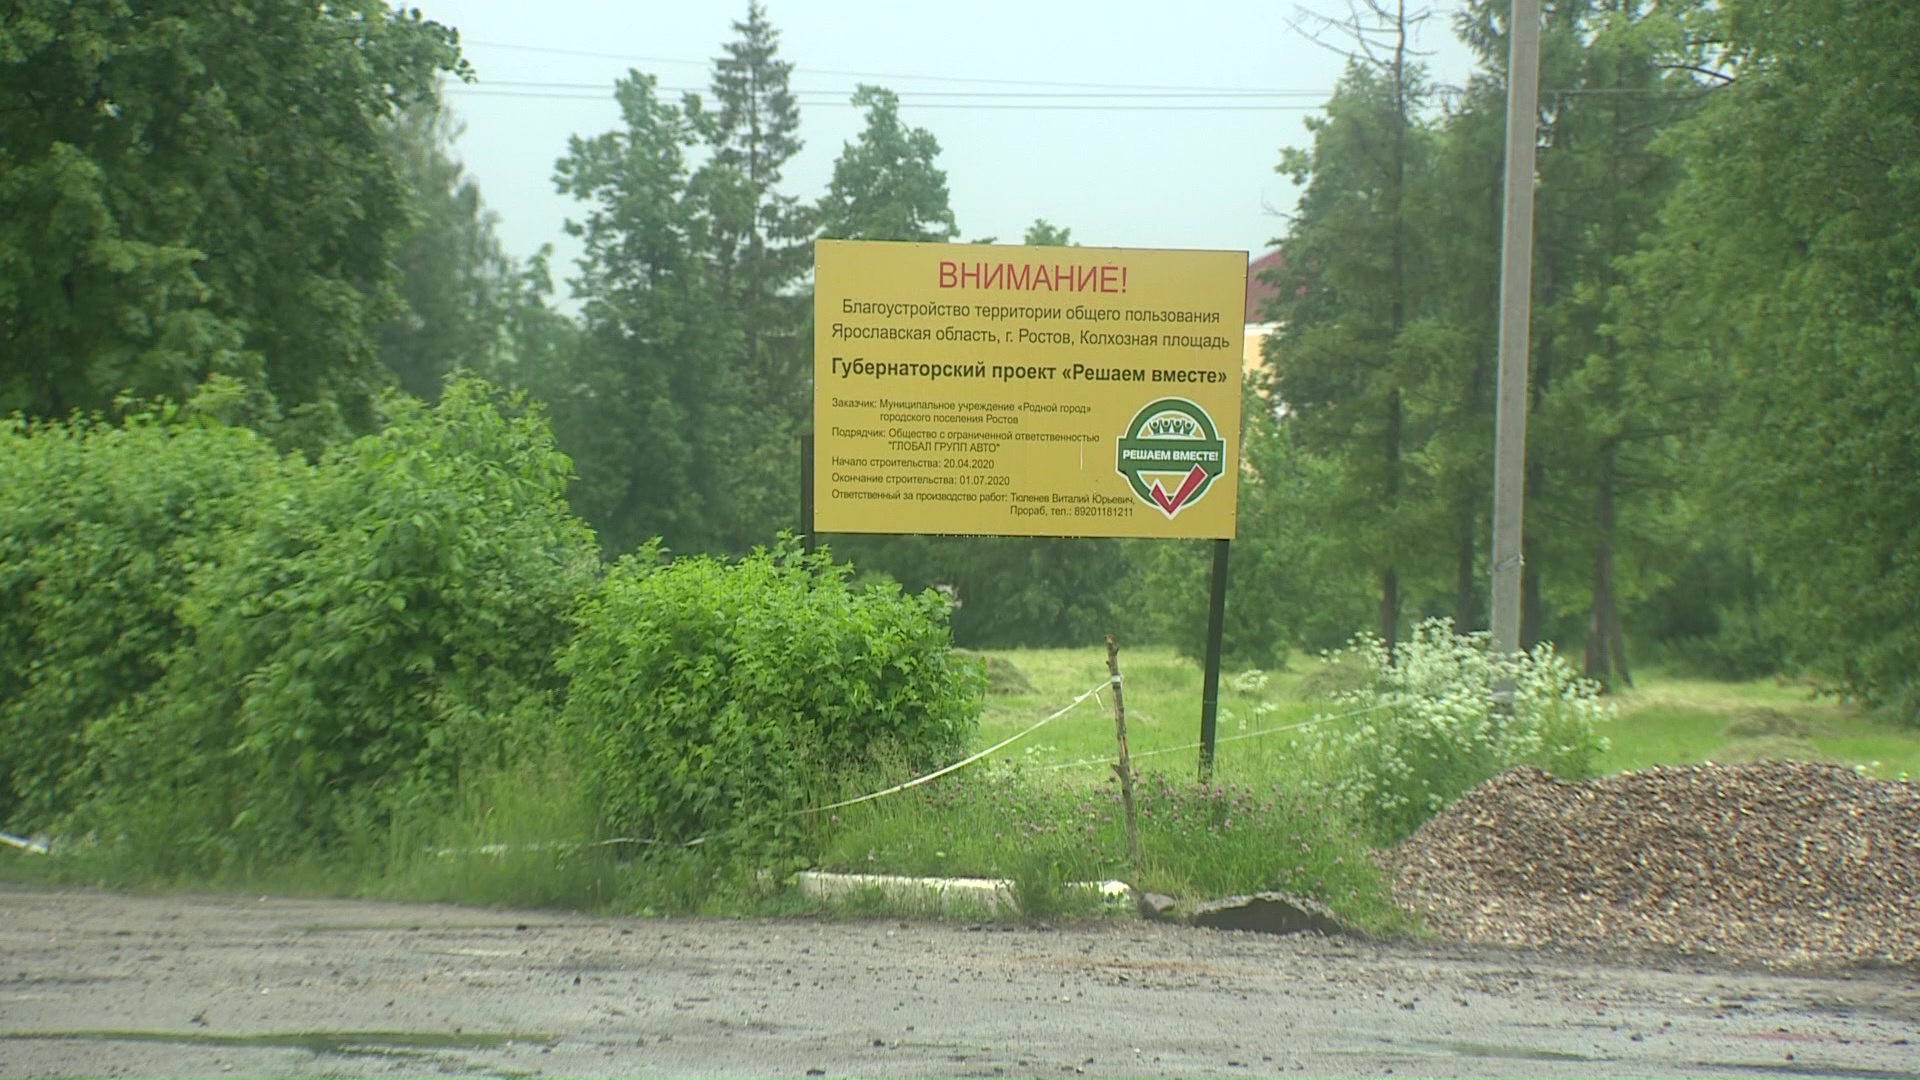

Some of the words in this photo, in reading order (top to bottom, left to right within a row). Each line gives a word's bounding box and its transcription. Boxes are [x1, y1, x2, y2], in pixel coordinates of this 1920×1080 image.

[939, 261, 1127, 293] ВНИМАНИЕ!
[842, 299, 970, 319] Благоустройство
[975, 304, 1061, 322] территории
[1066, 305, 1121, 322] общего
[1125, 309, 1220, 324] пользования
[831, 323, 931, 341] Ярославская
[935, 326, 1001, 344] область,
[1005, 333, 1014, 343] г.
[1019, 328, 1075, 346] Ростов,
[1080, 330, 1158, 347] Колхозная
[1162, 335, 1230, 350] площадь
[831, 357, 986, 380] Губернаторский
[992, 365, 1056, 382] проект
[1062, 363, 1145, 383] «Решаем
[1152, 368, 1227, 384] вместе»
[880, 398, 956, 411] Муниципальное
[958, 402, 1015, 413] учреждение
[880, 413, 931, 423] городского
[933, 415, 984, 424] поселения
[986, 414, 1019, 424] Ростов
[888, 427, 937, 439] Общество
[947, 431, 1013, 441] ограниченной
[1015, 432, 1100, 442] ответственностью
[934, 442, 967, 452] ГРУПП
[832, 456, 868, 467] Начало
[870, 459, 942, 469] строительства:
[943, 458, 995, 469] 20.04.2020
[1122, 449, 1171, 461] РЕШАЕМ
[1172, 450, 1219, 461] ВМЕСТЕ!
[832, 472, 883, 483] Окончание
[886, 476, 957, 485] строительства:
[959, 475, 1010, 485] 01.07.2020
[832, 488, 901, 500] Ответственный
[903, 492, 914, 501] за
[916, 492, 977, 503] производство
[979, 491, 1008, 503] работ:
[1010, 492, 1050, 503] Тюленев
[1052, 493, 1090, 504] Виталий
[1010, 505, 1048, 517] Прораб,
